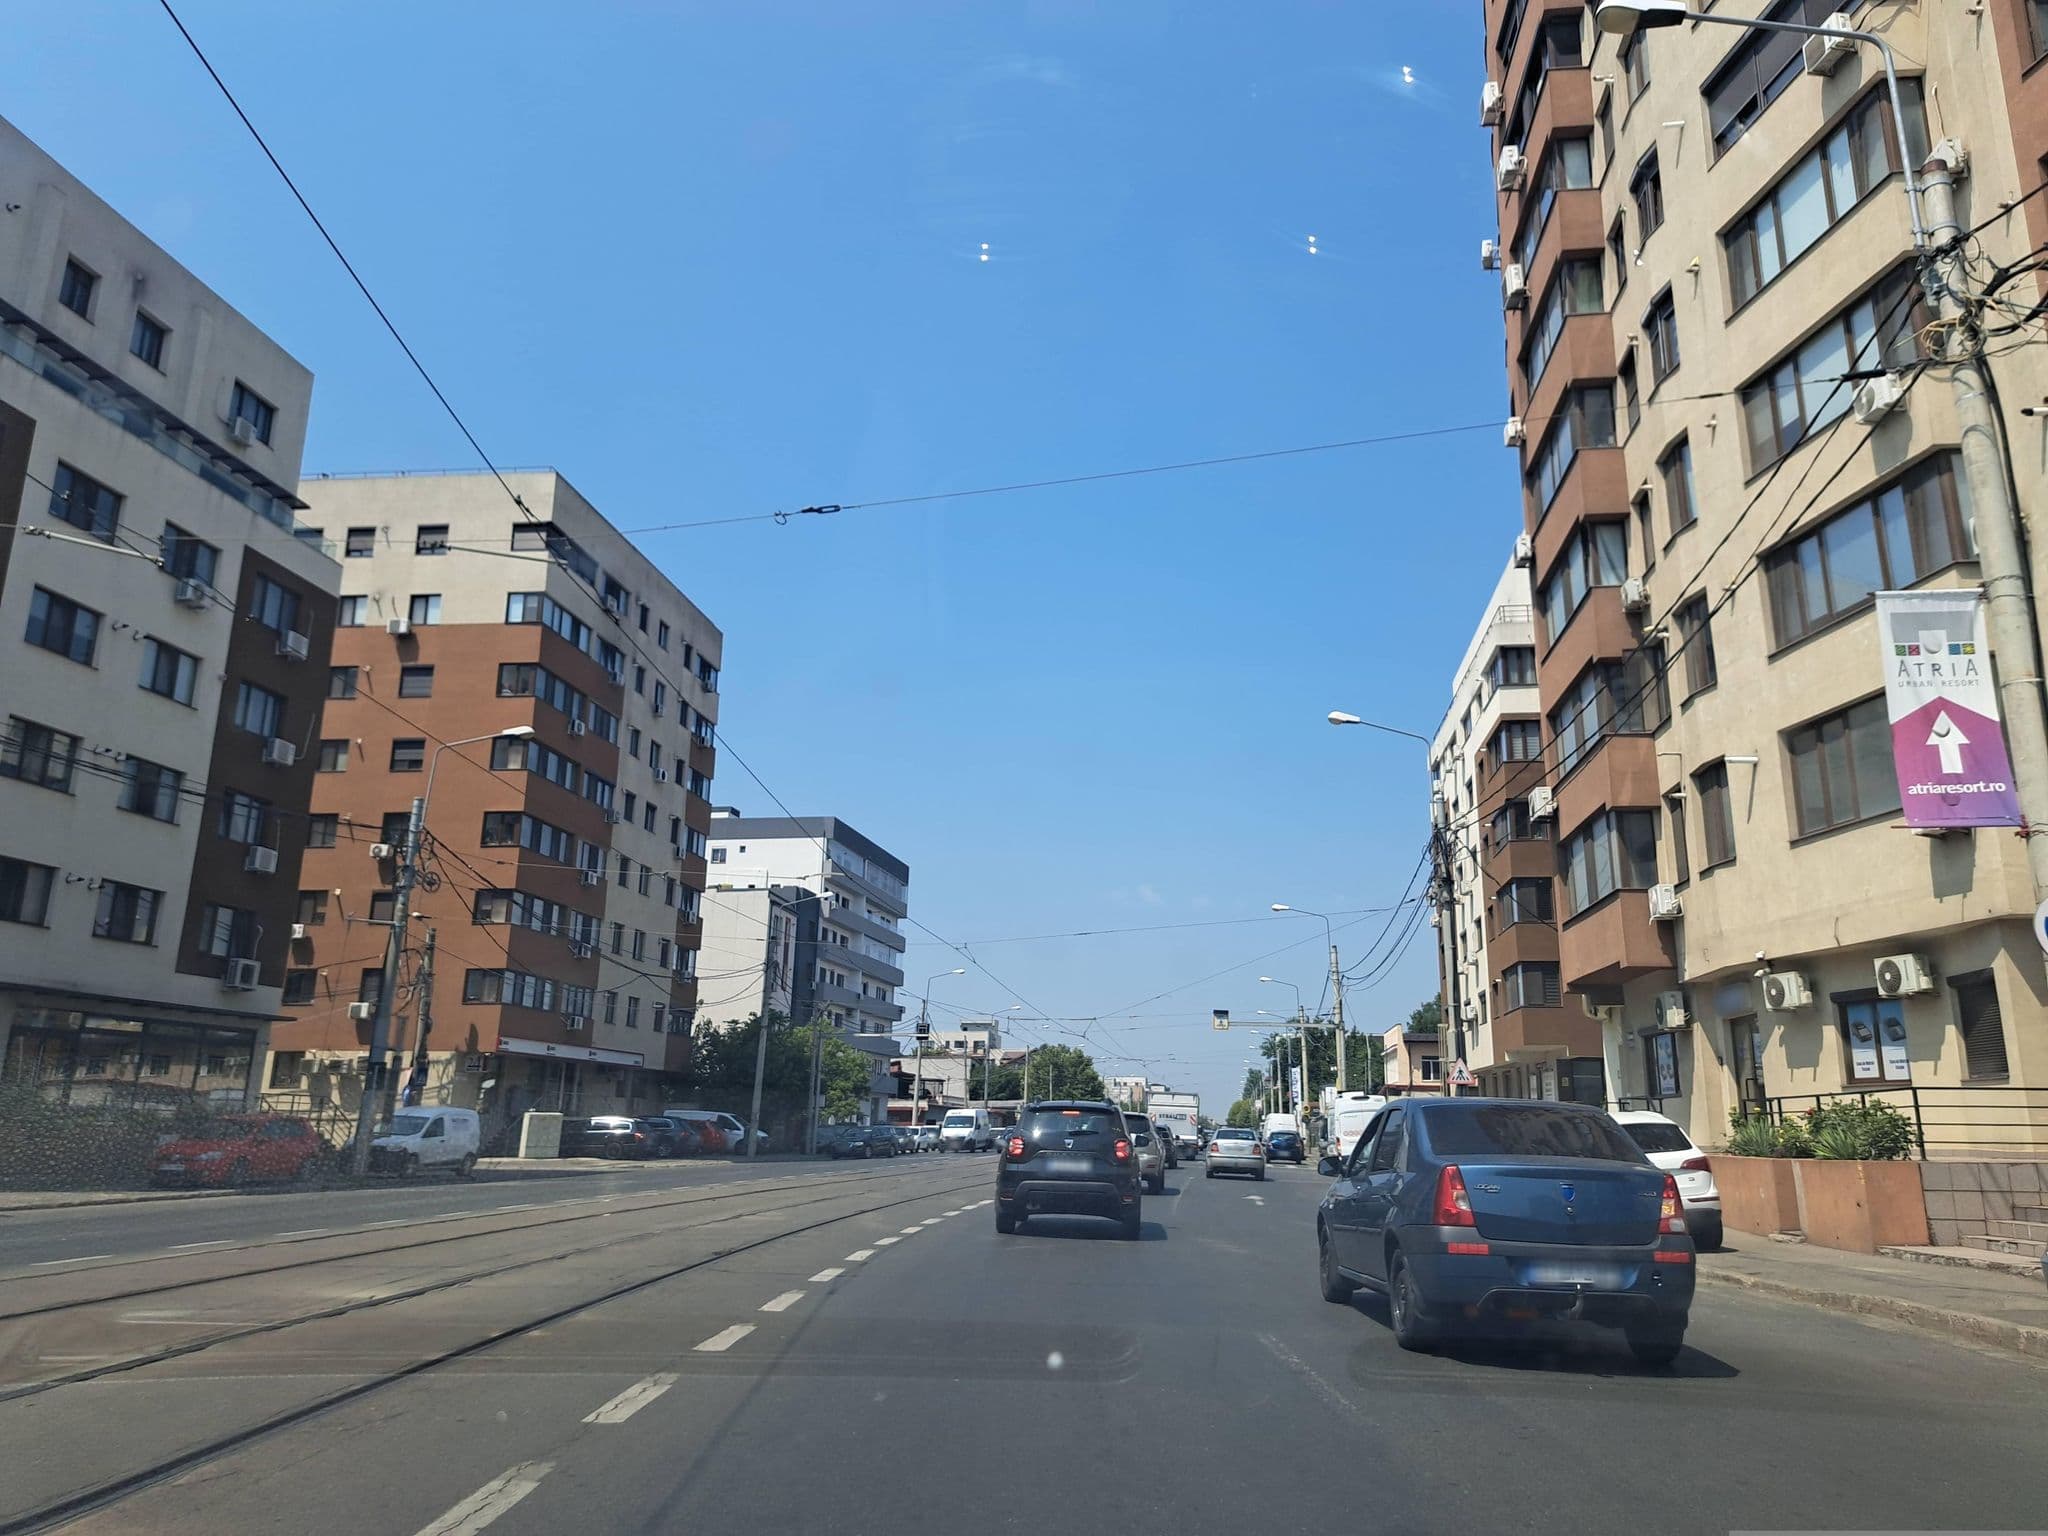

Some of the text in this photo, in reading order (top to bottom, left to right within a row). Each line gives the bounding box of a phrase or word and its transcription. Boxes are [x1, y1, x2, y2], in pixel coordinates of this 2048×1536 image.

[1898, 658, 1979, 678] ATRIA
[1898, 679, 1980, 688] URBAN RESORT
[1907, 781, 2006, 795] atriaresort.ro
